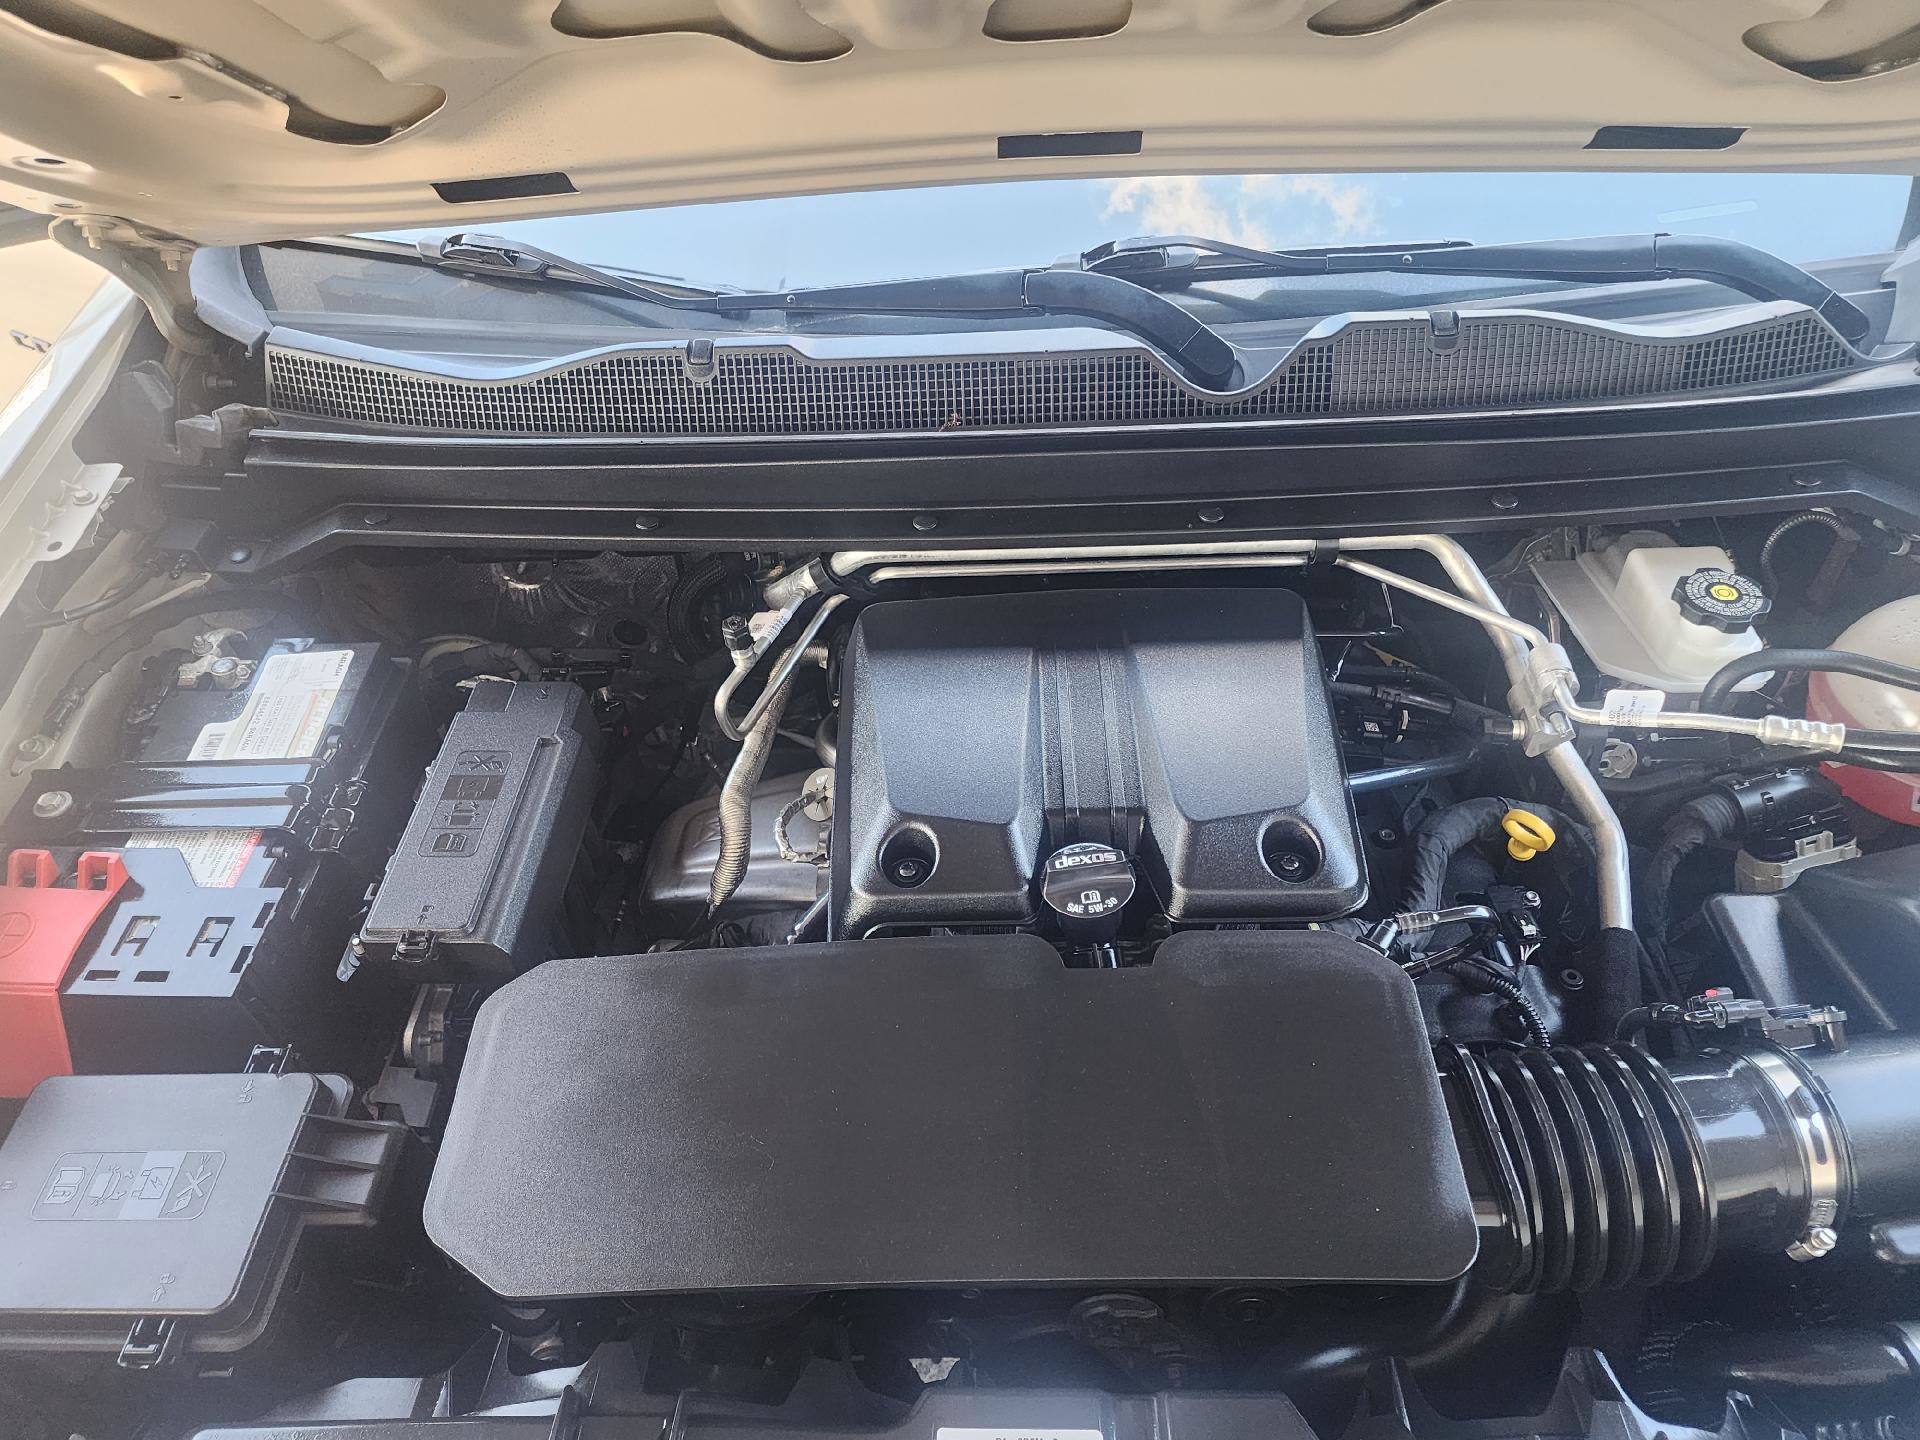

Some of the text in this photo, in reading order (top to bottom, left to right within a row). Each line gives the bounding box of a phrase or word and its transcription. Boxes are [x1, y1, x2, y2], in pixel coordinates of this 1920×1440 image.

[1055, 852, 1117, 869] dexos
[1066, 897, 1118, 914] SAE 5W-30
